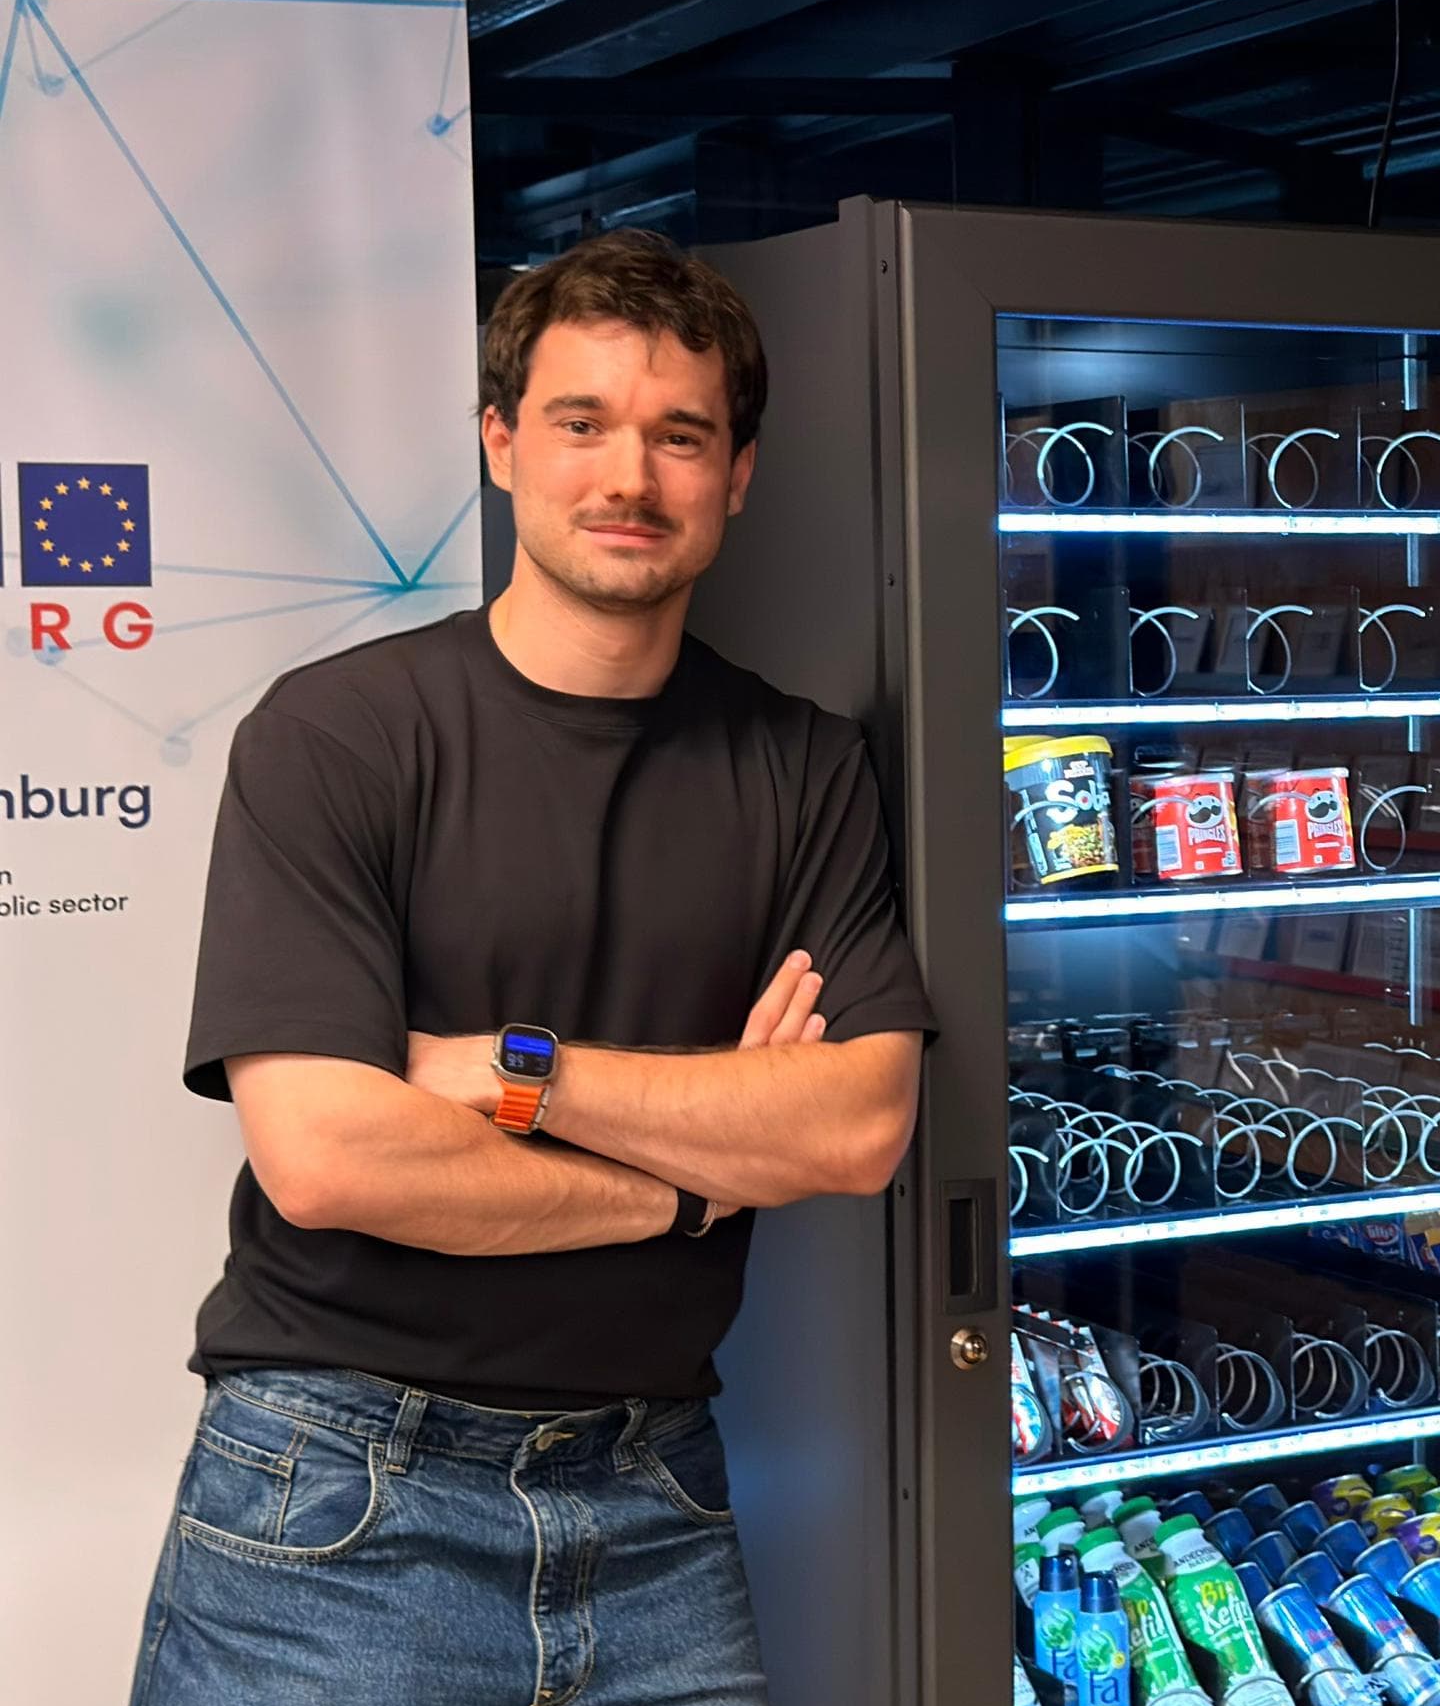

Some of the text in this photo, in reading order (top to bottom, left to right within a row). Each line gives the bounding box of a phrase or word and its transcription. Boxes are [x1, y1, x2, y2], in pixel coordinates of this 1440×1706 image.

[1044, 779, 1111, 824] Soba
[49, 893, 128, 914] sector
[1089, 1669, 1120, 1706] Fa
